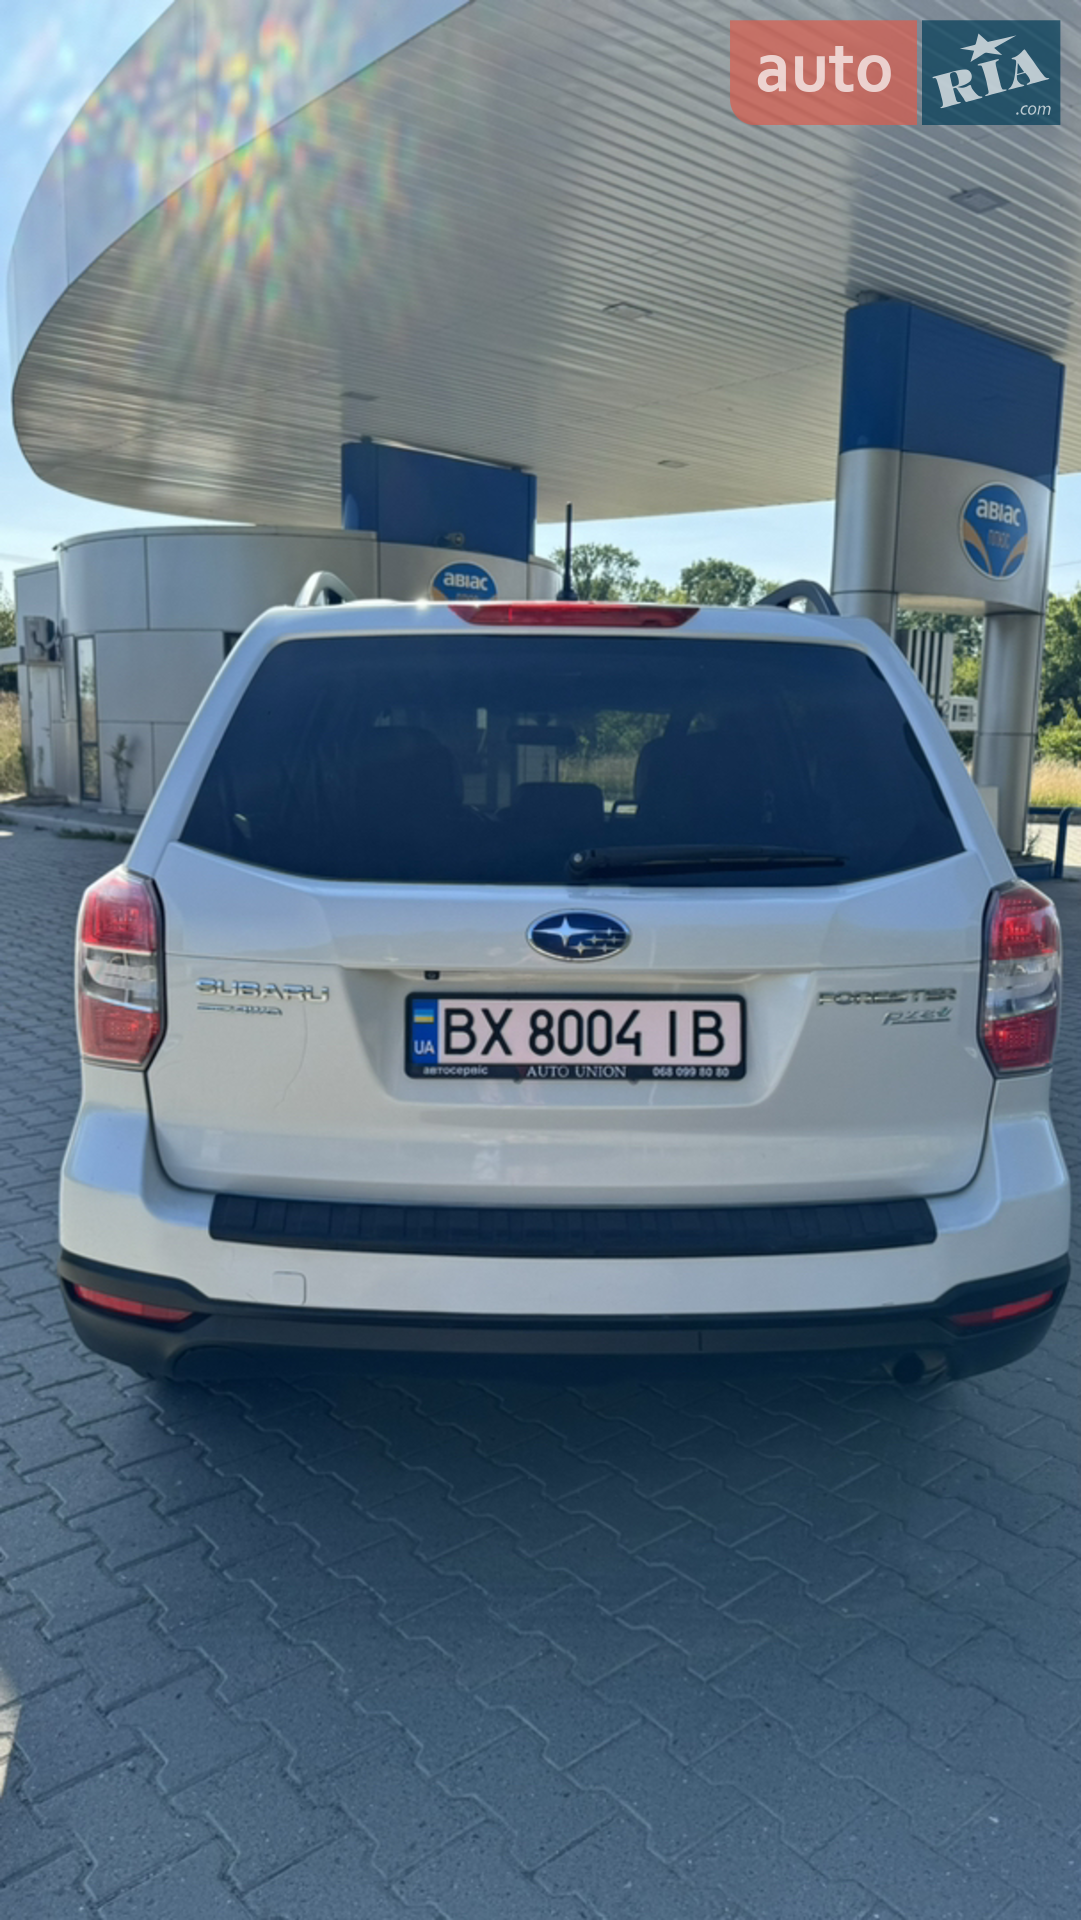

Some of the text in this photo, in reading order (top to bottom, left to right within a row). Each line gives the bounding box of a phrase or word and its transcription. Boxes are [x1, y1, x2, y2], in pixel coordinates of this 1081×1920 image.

[195, 977, 330, 1003] SUBARU
[818, 987, 957, 1006] FORESTER
[444, 1008, 725, 1057] BX 8004 IB
[413, 1040, 435, 1055] UA
[422, 1065, 489, 1077] автосервіс
[526, 1066, 627, 1078] AUTO UNION
[652, 1066, 673, 1077] 068
[675, 1066, 696, 1078] 099
[715, 1067, 730, 1078] 80
